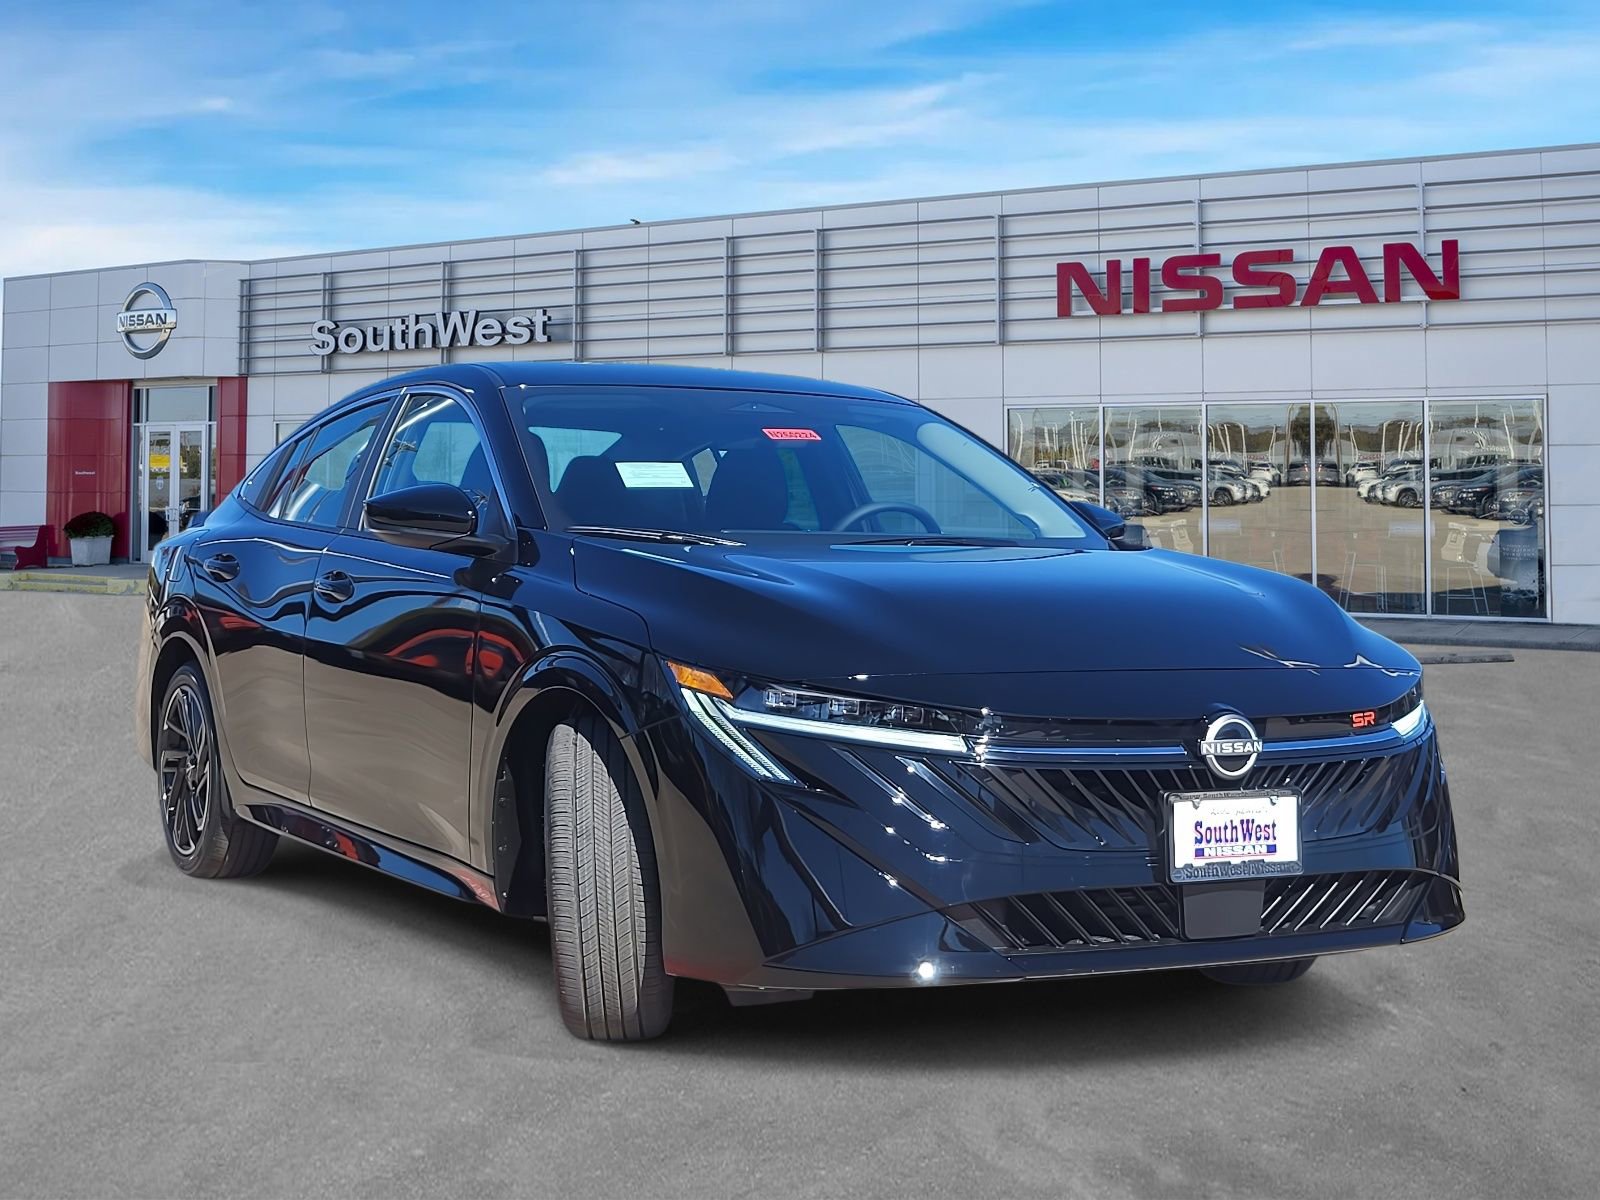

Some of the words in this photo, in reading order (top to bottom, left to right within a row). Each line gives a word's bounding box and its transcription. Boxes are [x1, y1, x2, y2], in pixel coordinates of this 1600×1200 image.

[1056, 239, 1460, 317] NISSAN
[119, 313, 167, 327] NISSAN
[309, 308, 550, 356] SouthWest
[1352, 711, 1375, 728] SR
[1202, 741, 1263, 753] NISSAN
[1194, 819, 1277, 844] SouthWest
[1204, 844, 1268, 857] NISSAN
